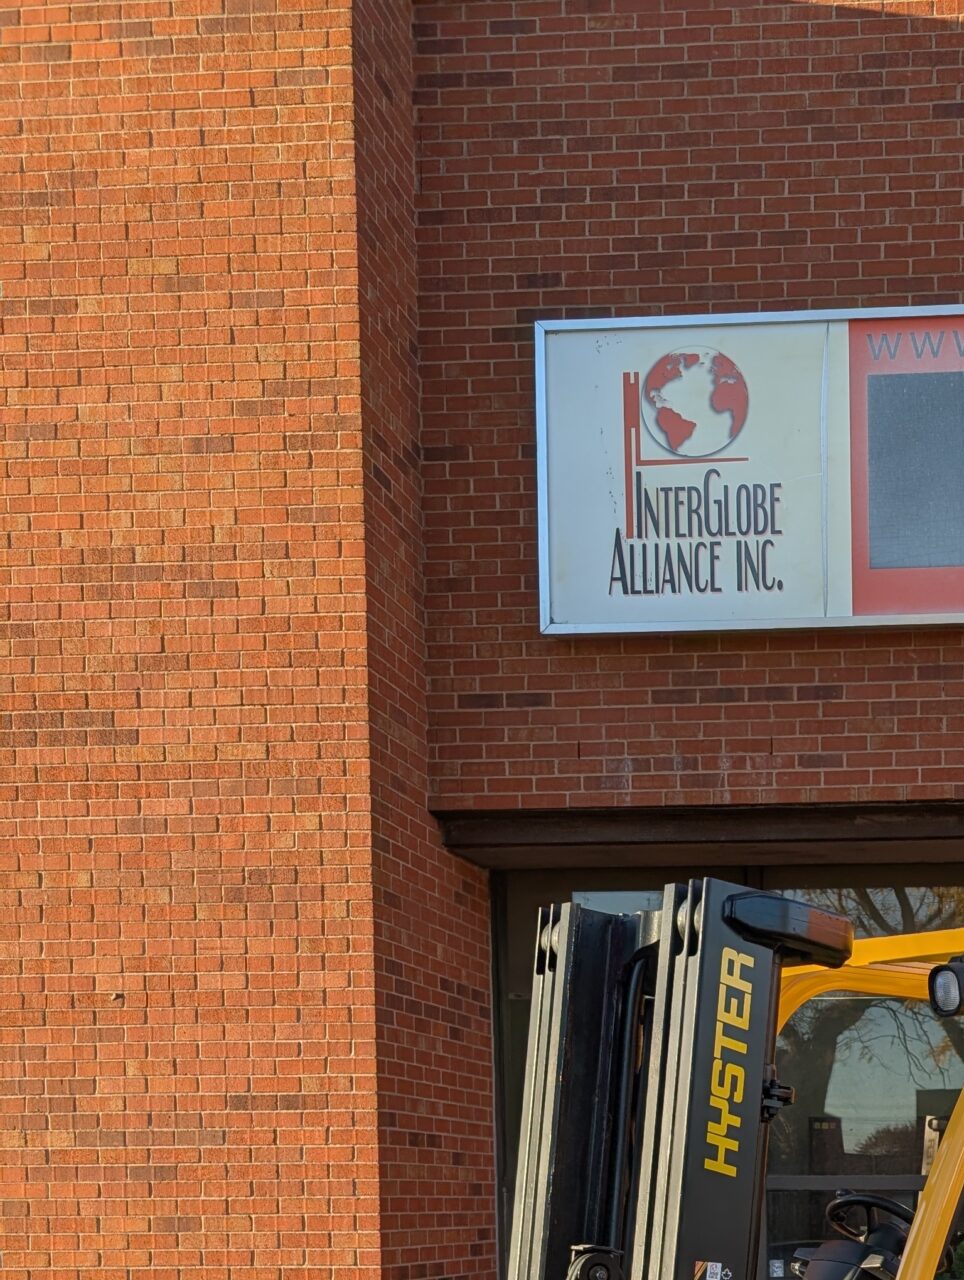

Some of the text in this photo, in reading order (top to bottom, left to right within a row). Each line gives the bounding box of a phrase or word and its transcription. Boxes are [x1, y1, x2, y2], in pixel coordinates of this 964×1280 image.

[608, 527, 784, 595] ALLIANCE INC.
[703, 946, 756, 1178] HYSTER
